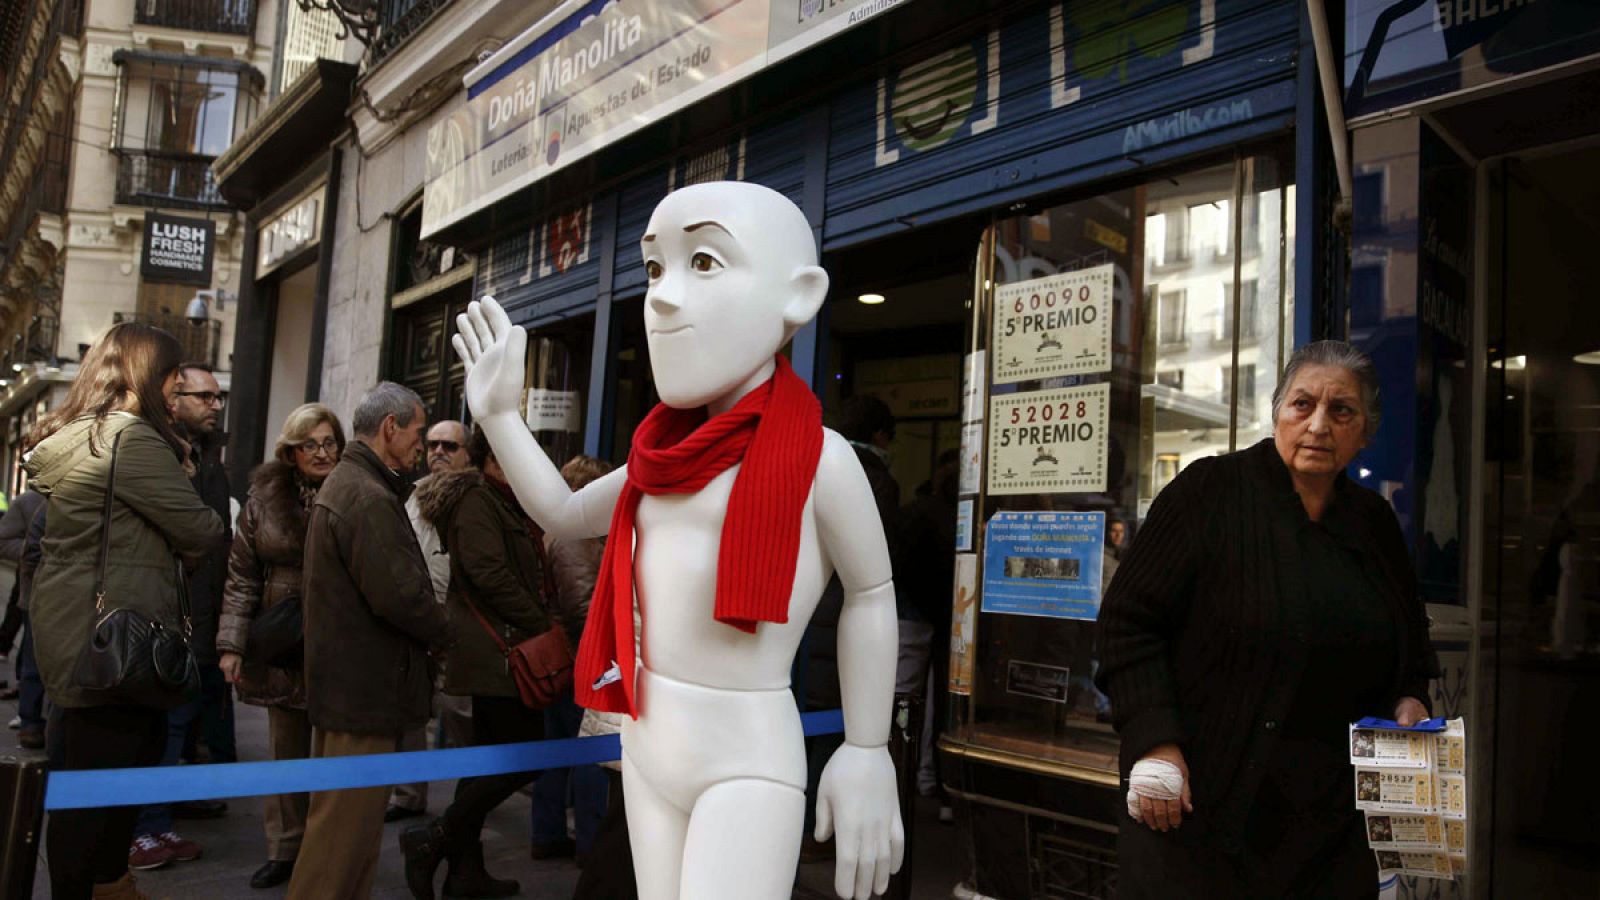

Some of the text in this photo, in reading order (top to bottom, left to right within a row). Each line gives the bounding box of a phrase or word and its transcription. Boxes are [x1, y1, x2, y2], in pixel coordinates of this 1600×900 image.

[487, 14, 641, 131] Doña Manolita
[567, 89, 626, 135] Apuestas
[631, 68, 653, 99] del
[657, 45, 711, 86] Estado
[152, 222, 206, 242] LUSH
[150, 250, 204, 263] HANDMADE
[151, 237, 204, 255] FRESH
[149, 257, 203, 271] COSMETICS
[1014, 285, 1090, 313] 60090
[1023, 305, 1097, 334] PREMIO
[1011, 400, 1086, 424] 52028
[1018, 422, 1093, 446] PREMIO
